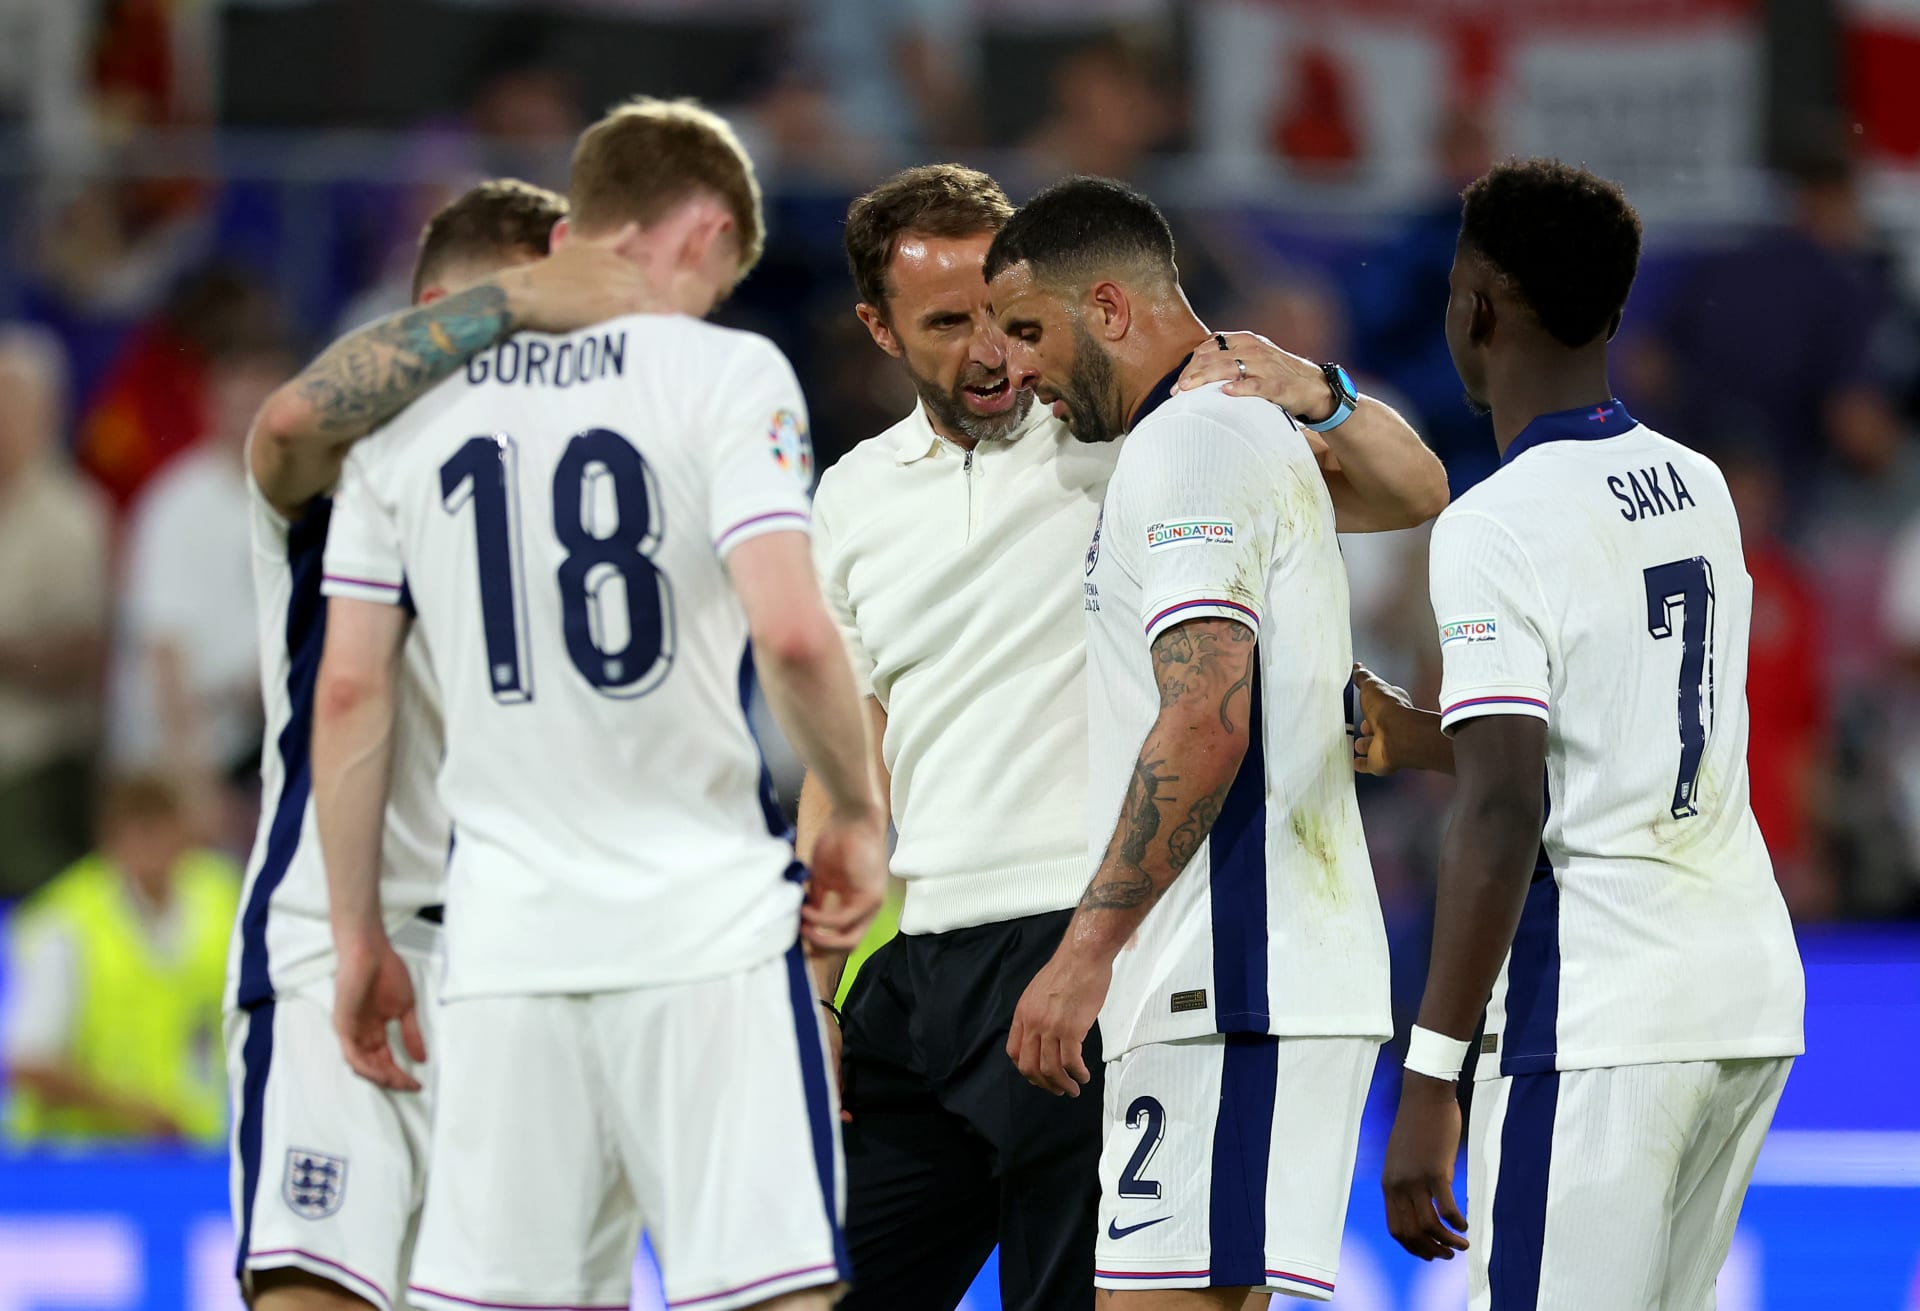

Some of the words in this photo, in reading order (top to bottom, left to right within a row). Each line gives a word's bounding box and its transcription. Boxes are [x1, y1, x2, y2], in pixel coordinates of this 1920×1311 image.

[466, 331, 626, 388] GORDON
[1606, 461, 1697, 522] SAKA
[439, 427, 678, 706] 18
[1643, 555, 1716, 820] 7
[1118, 1095, 1167, 1200] 2
